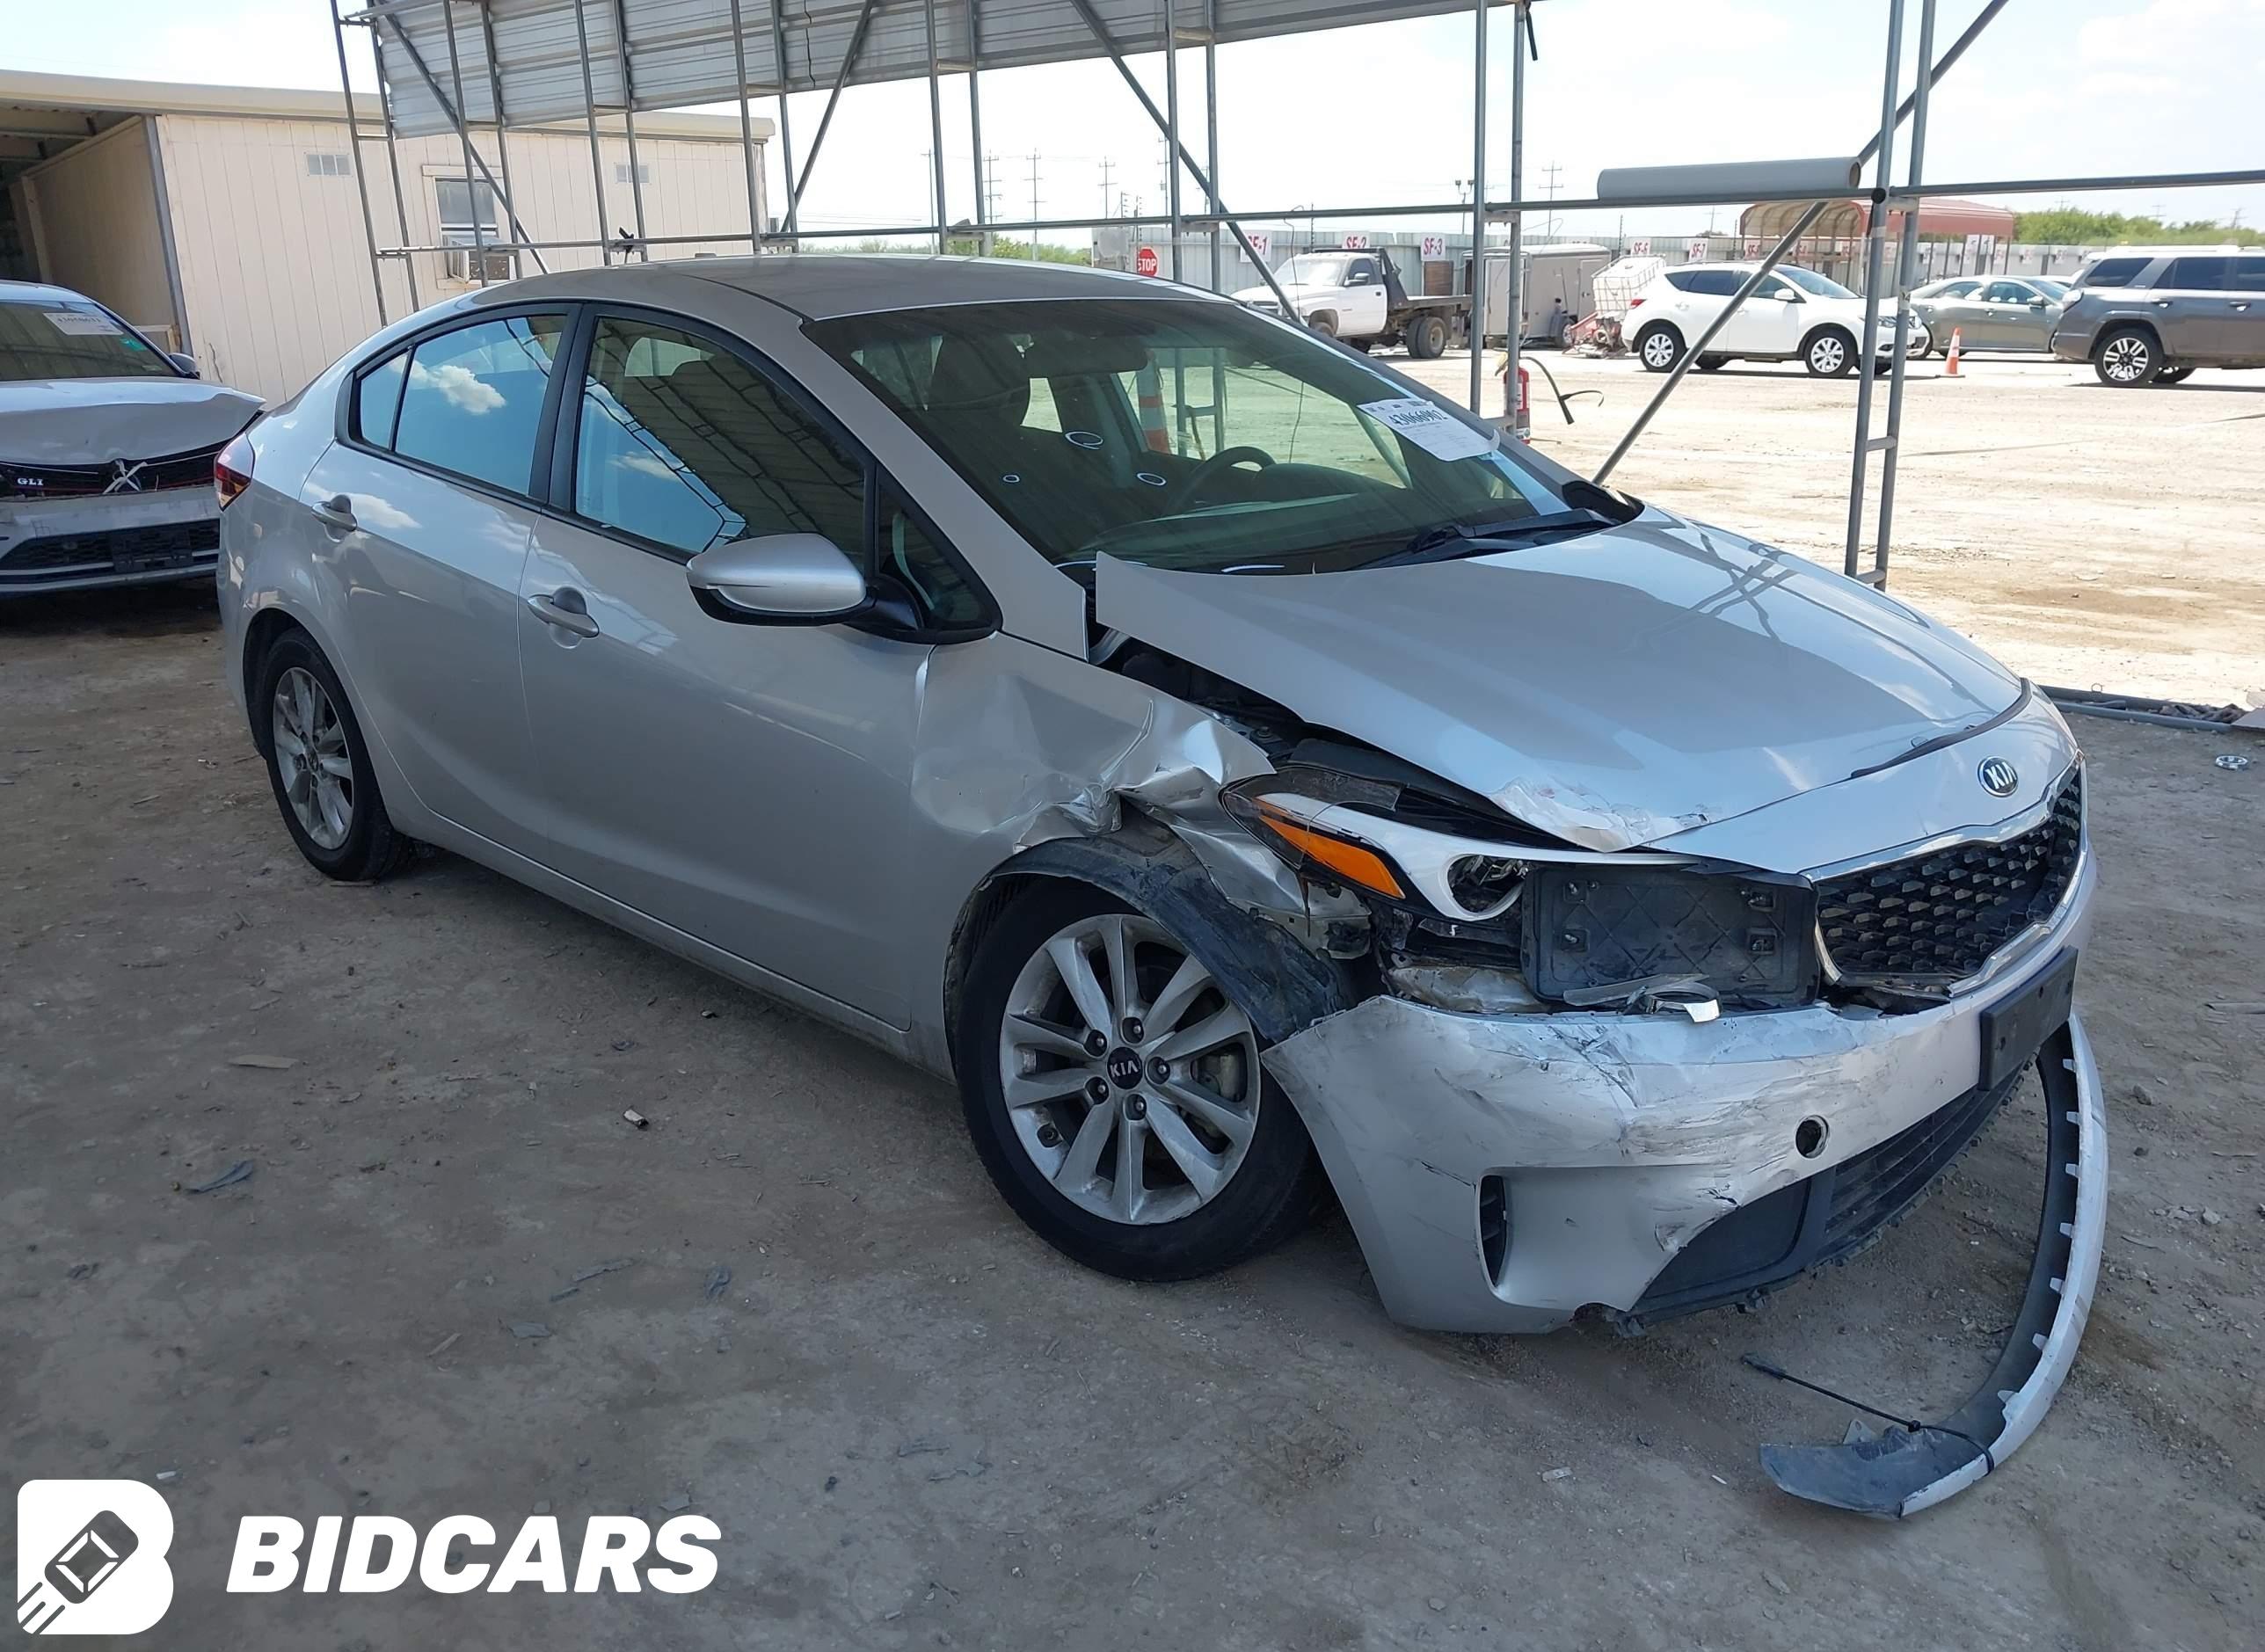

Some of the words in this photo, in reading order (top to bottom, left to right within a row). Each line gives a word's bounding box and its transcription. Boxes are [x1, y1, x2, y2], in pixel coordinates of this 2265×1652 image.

[1424, 237, 1443, 255] SF-3
[1138, 258, 1157, 272] STOP
[17, 477, 44, 486] GLI
[1985, 761, 2018, 790] KIA
[1110, 1060, 1139, 1078] KIA
